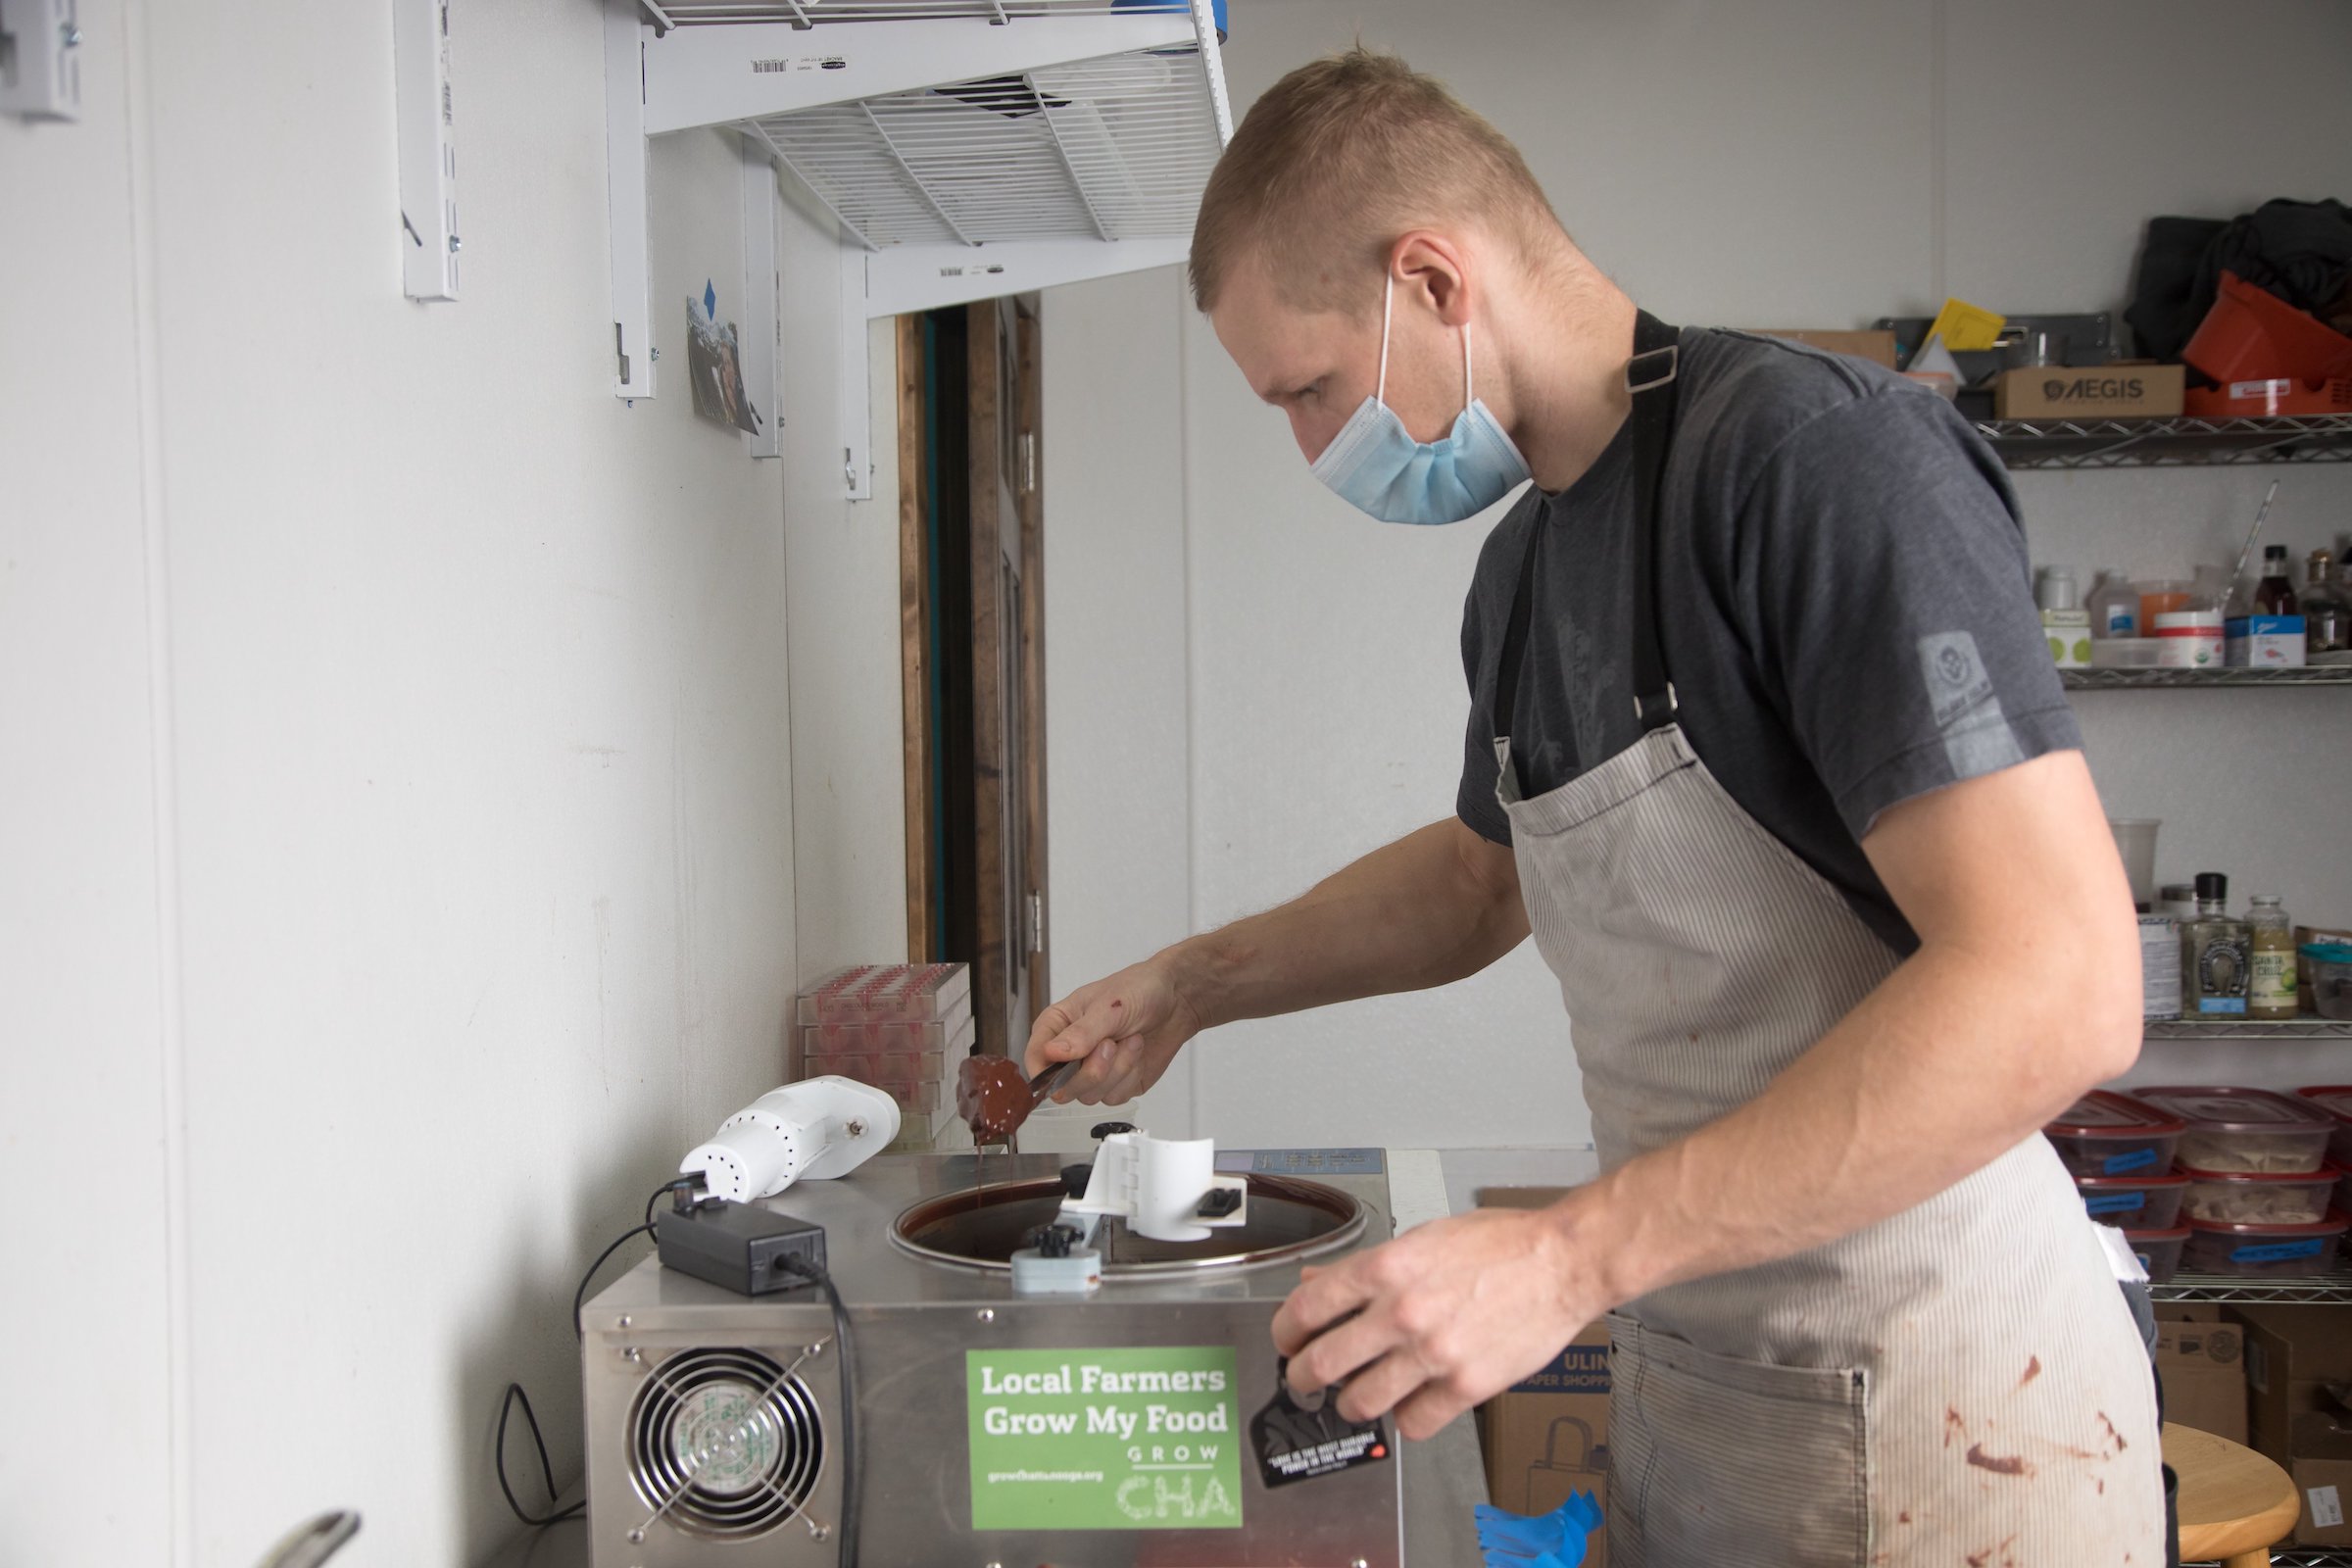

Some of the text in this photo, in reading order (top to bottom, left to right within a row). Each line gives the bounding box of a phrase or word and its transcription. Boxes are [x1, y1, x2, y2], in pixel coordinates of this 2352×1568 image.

[2065, 377, 2145, 399] AEGIS
[982, 1364, 1226, 1395] Local Farmers
[984, 1402, 1229, 1441] Grow My Food
[1127, 1445, 1218, 1462] GROW
[1116, 1473, 1236, 1520] CHA
